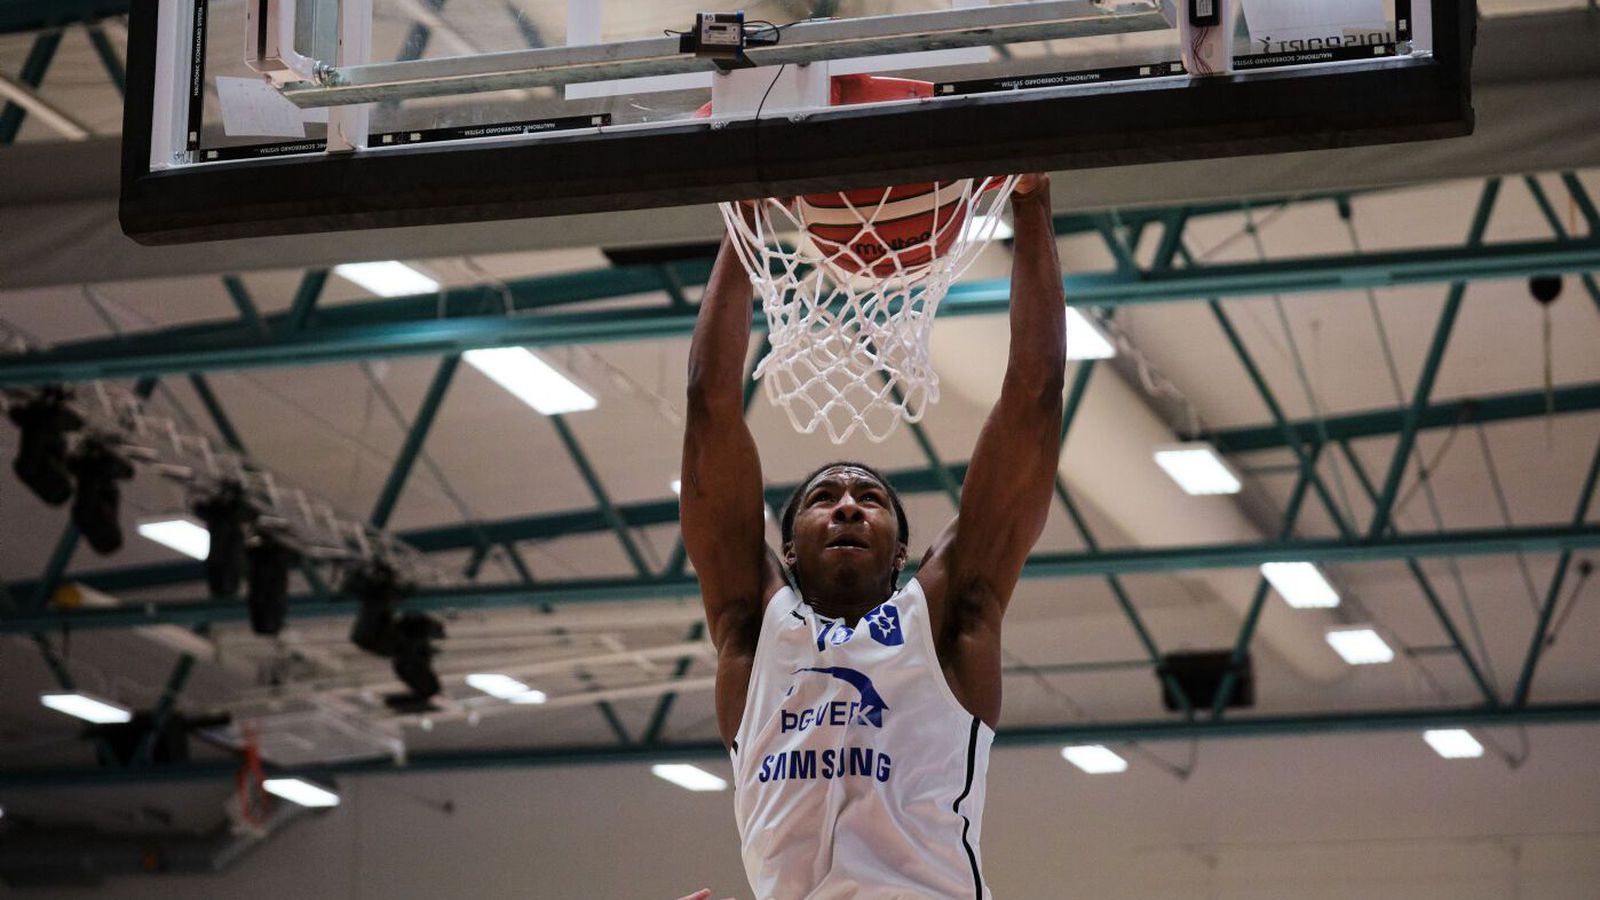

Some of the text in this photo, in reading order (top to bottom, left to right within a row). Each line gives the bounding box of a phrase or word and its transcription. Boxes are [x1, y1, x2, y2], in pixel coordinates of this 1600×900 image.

[195, 28, 203, 64] SCOREBOARD
[1254, 54, 1296, 65] SCOREBOARD
[1298, 51, 1333, 61] NAUTRONIC
[1001, 73, 1100, 88] NAUTRONIC SCOREBOARD SYSTEM
[486, 125, 522, 134] SCOREBOARD
[524, 123, 556, 132] NAUTRONIC
[280, 143, 316, 152] SCOREBOARD
[759, 747, 891, 783] SAMSUNG
